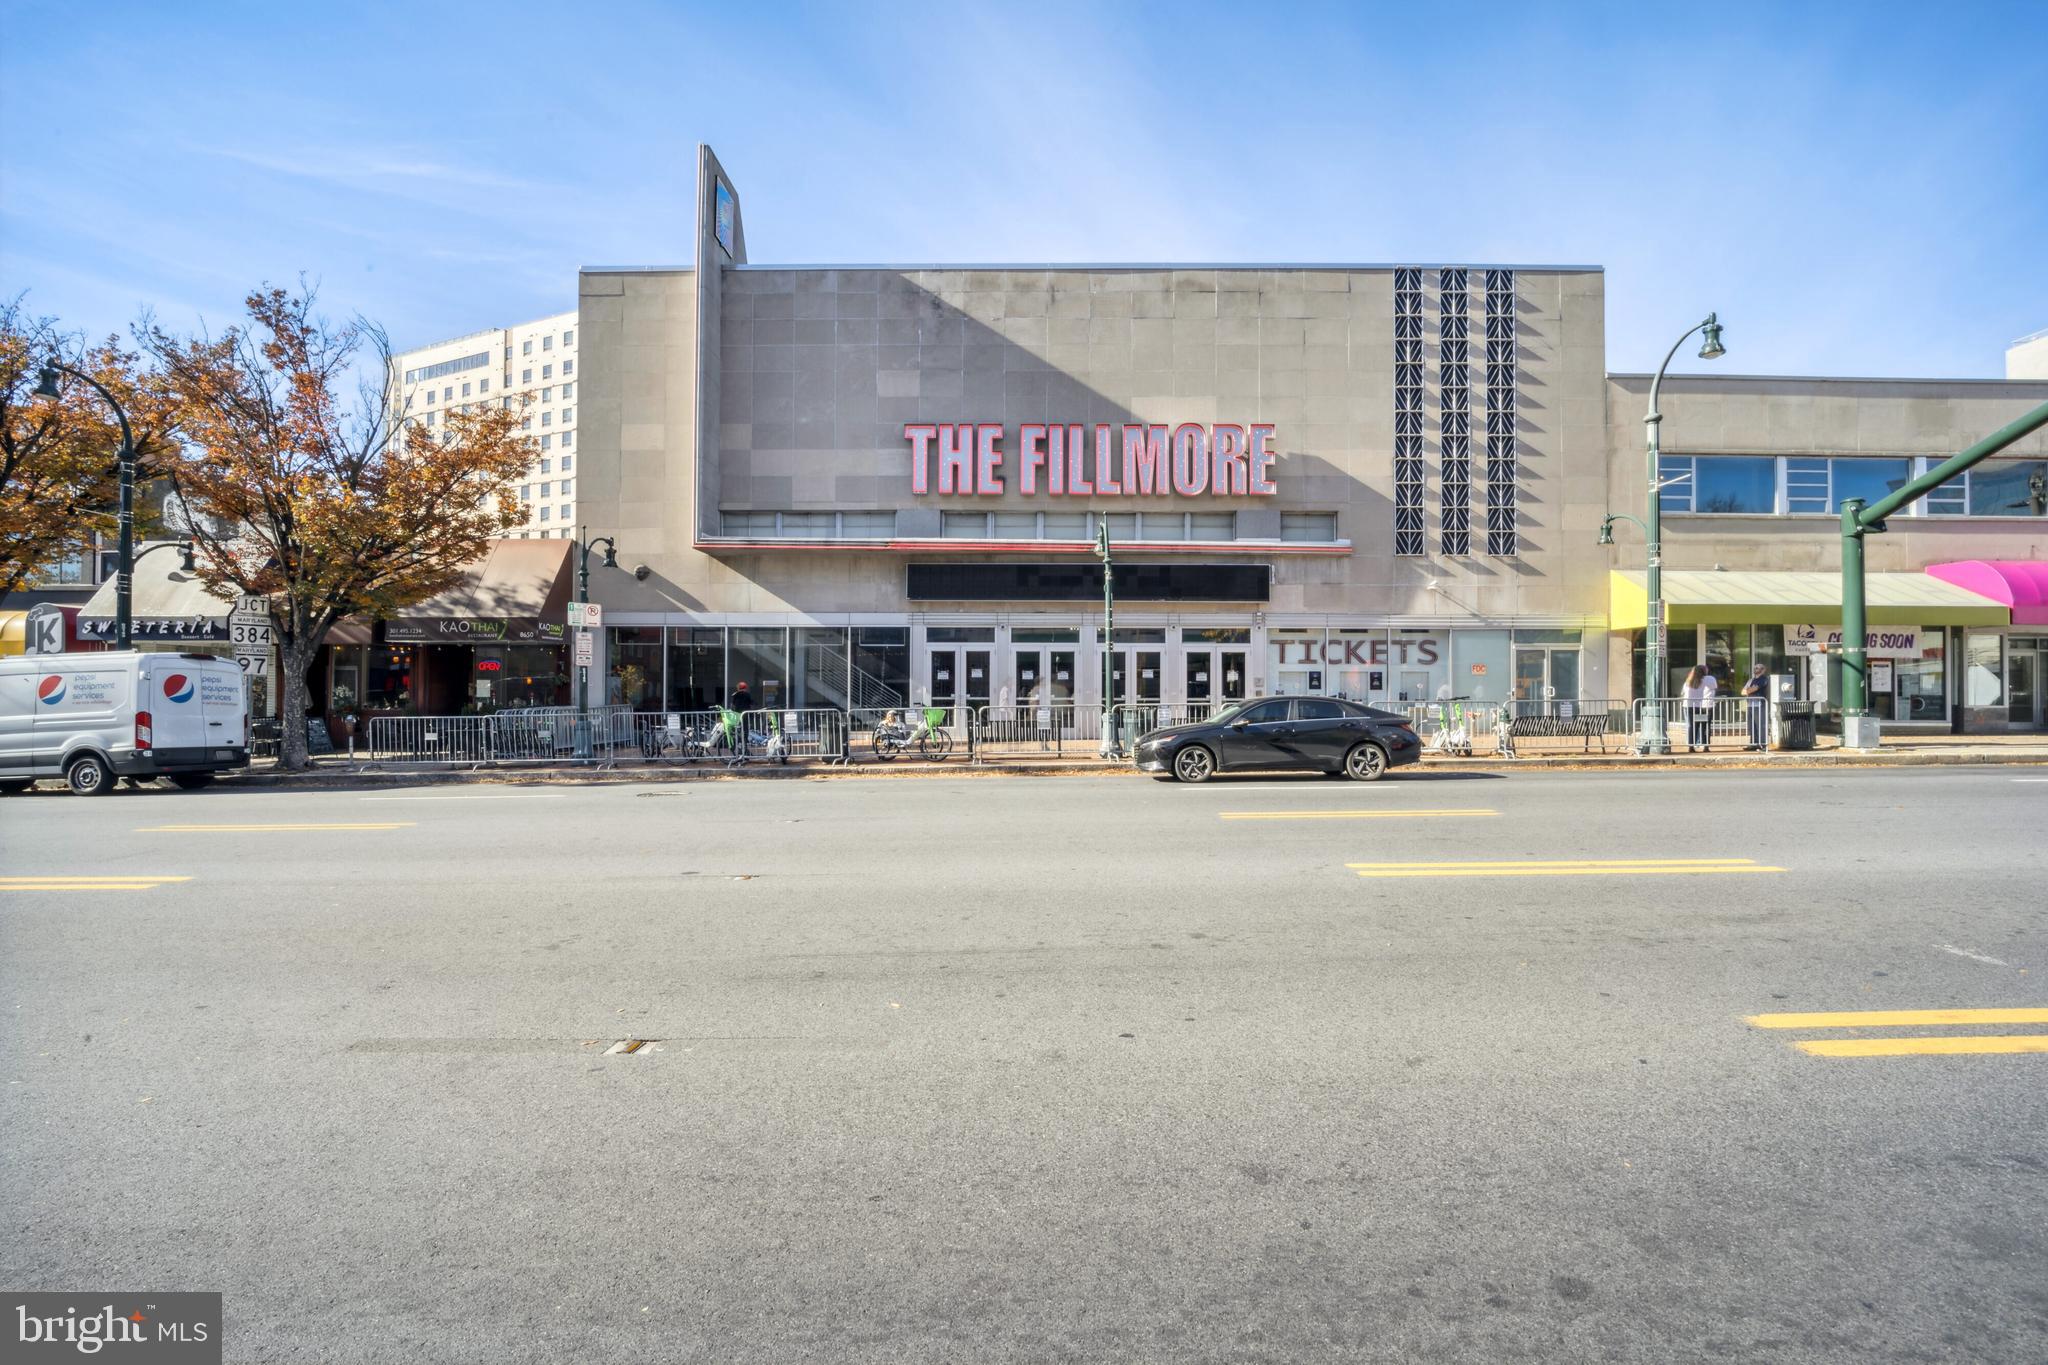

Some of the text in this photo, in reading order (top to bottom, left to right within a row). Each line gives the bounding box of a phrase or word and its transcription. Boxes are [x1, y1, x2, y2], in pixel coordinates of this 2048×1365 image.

[904, 422, 1277, 497] THE FILLMORE
[240, 599, 267, 612] JCT
[82, 620, 212, 635] SWETERIA
[234, 627, 270, 643] 384
[1879, 633, 1915, 649] SOON
[1270, 639, 1439, 665] TICKETS
[238, 657, 266, 674] 97
[479, 661, 501, 671] OPEN
[74, 673, 96, 682] pepsi
[202, 676, 222, 685] pepsi
[73, 682, 116, 691] equipment
[202, 685, 239, 693] equipment
[72, 692, 105, 700] services
